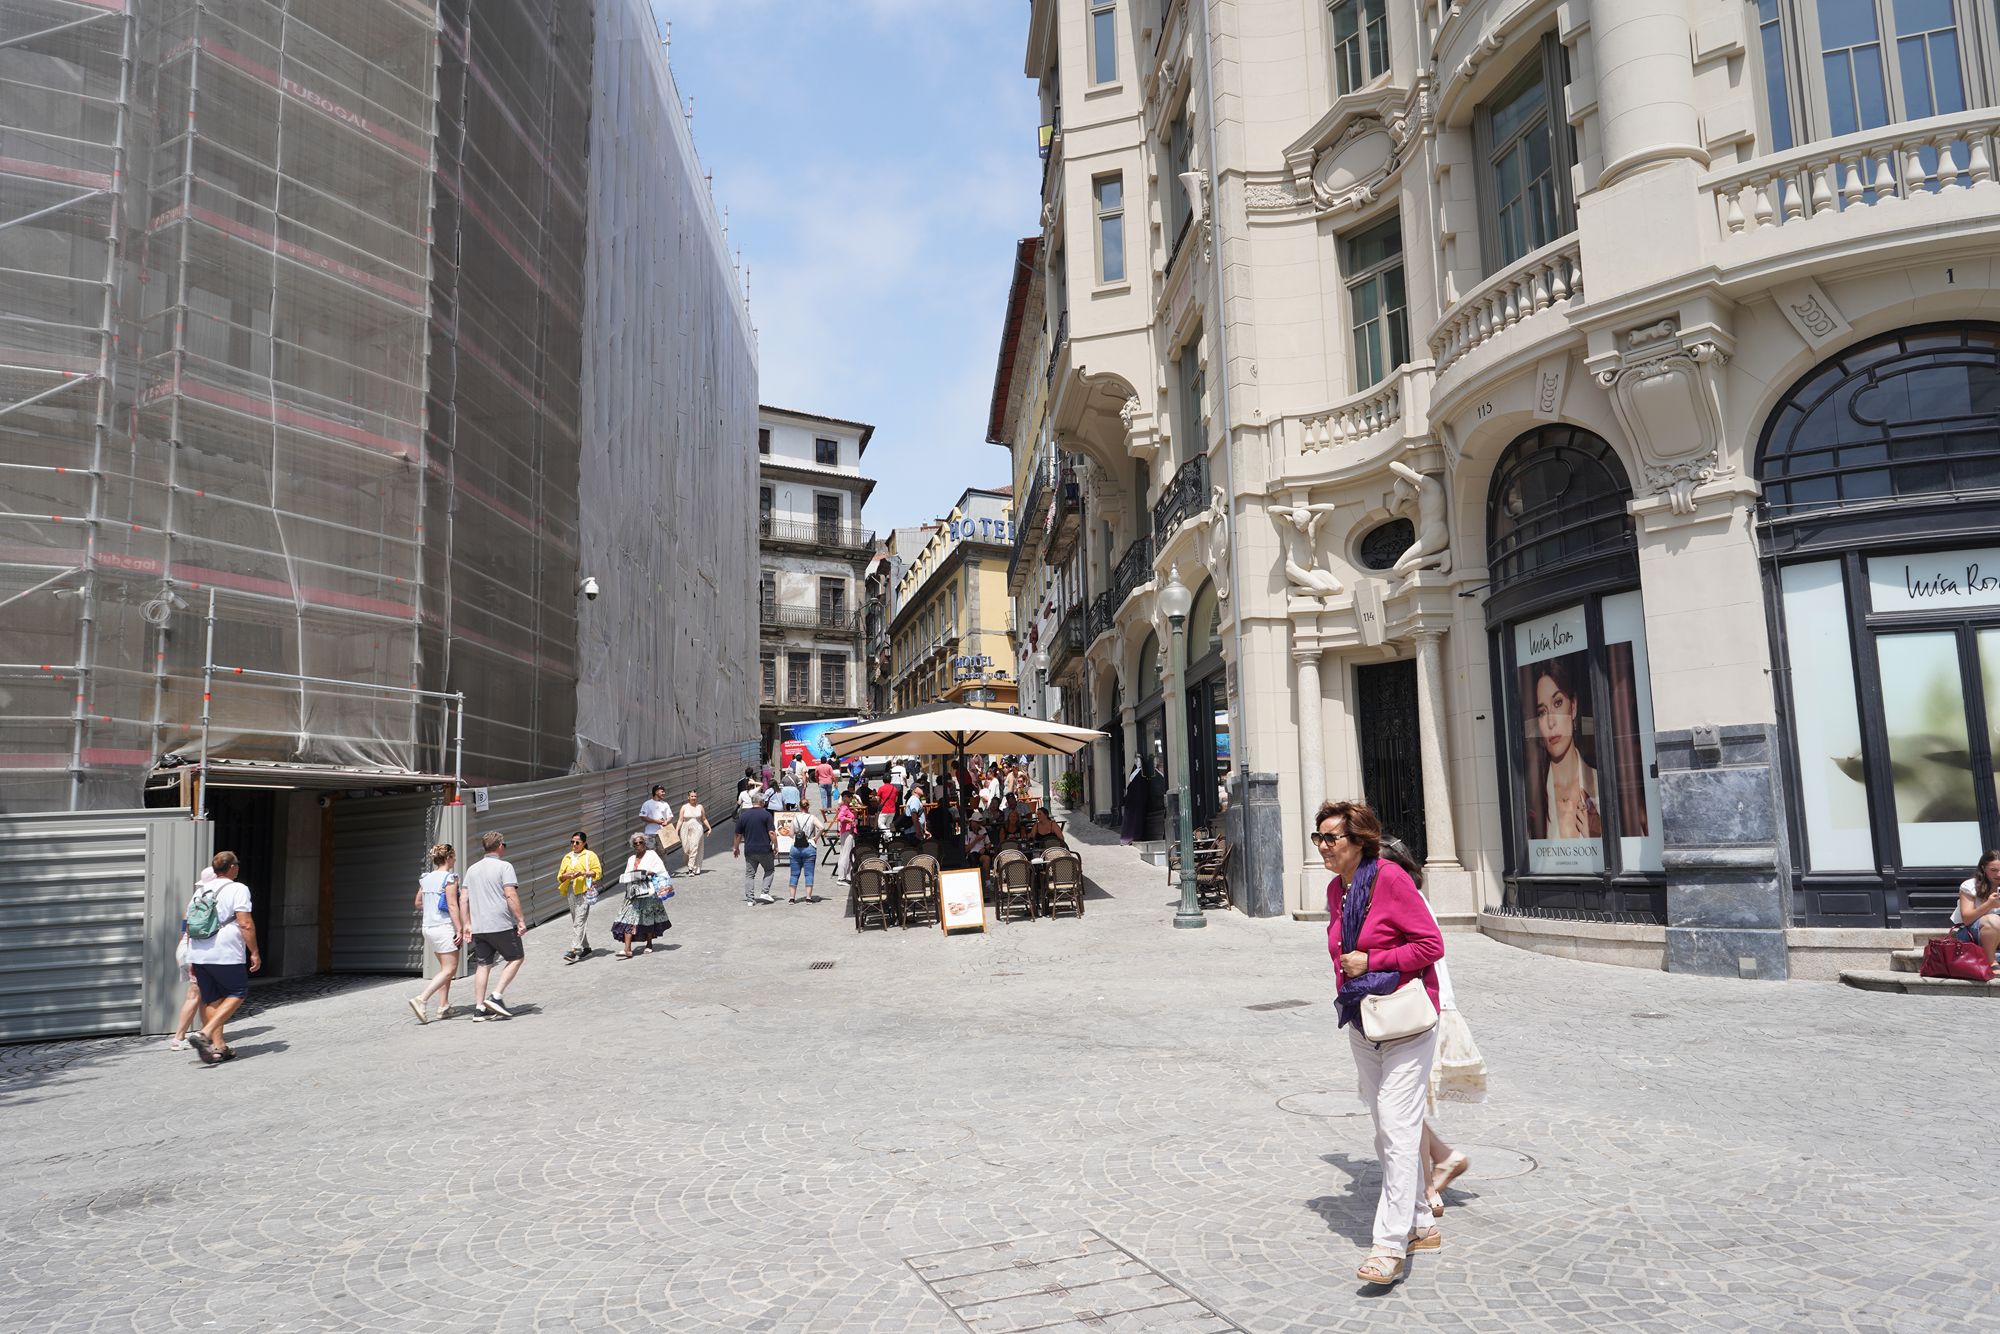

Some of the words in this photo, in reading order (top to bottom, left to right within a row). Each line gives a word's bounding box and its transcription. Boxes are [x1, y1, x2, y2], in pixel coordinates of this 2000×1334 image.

[281, 77, 372, 133] TUBOGAL
[1946, 268, 1956, 284] 1
[1477, 401, 1493, 419] 115
[1363, 611, 1375, 622] 114
[954, 655, 995, 669] HOTEL
[1536, 846, 1572, 857] OPENING
[1572, 846, 1599, 857] SOON
